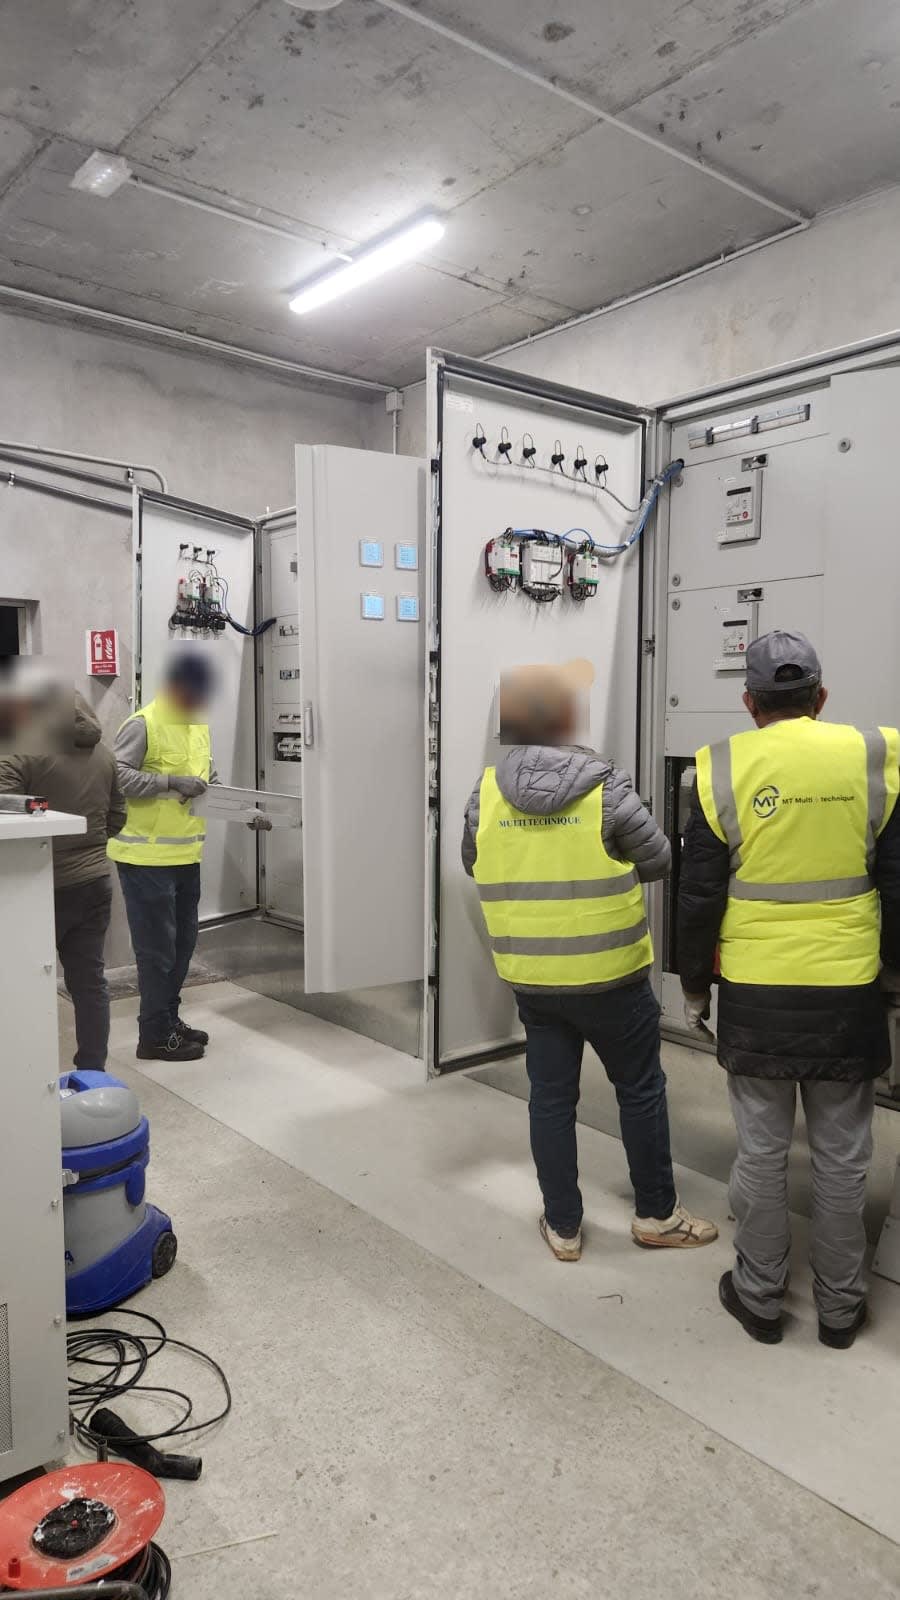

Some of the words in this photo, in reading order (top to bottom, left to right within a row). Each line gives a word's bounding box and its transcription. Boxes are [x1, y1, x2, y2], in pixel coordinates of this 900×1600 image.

[753, 796, 779, 808] MT
[795, 796, 812, 804] Multi
[820, 795, 855, 803] technique
[528, 816, 582, 826] TECHNIQUE
